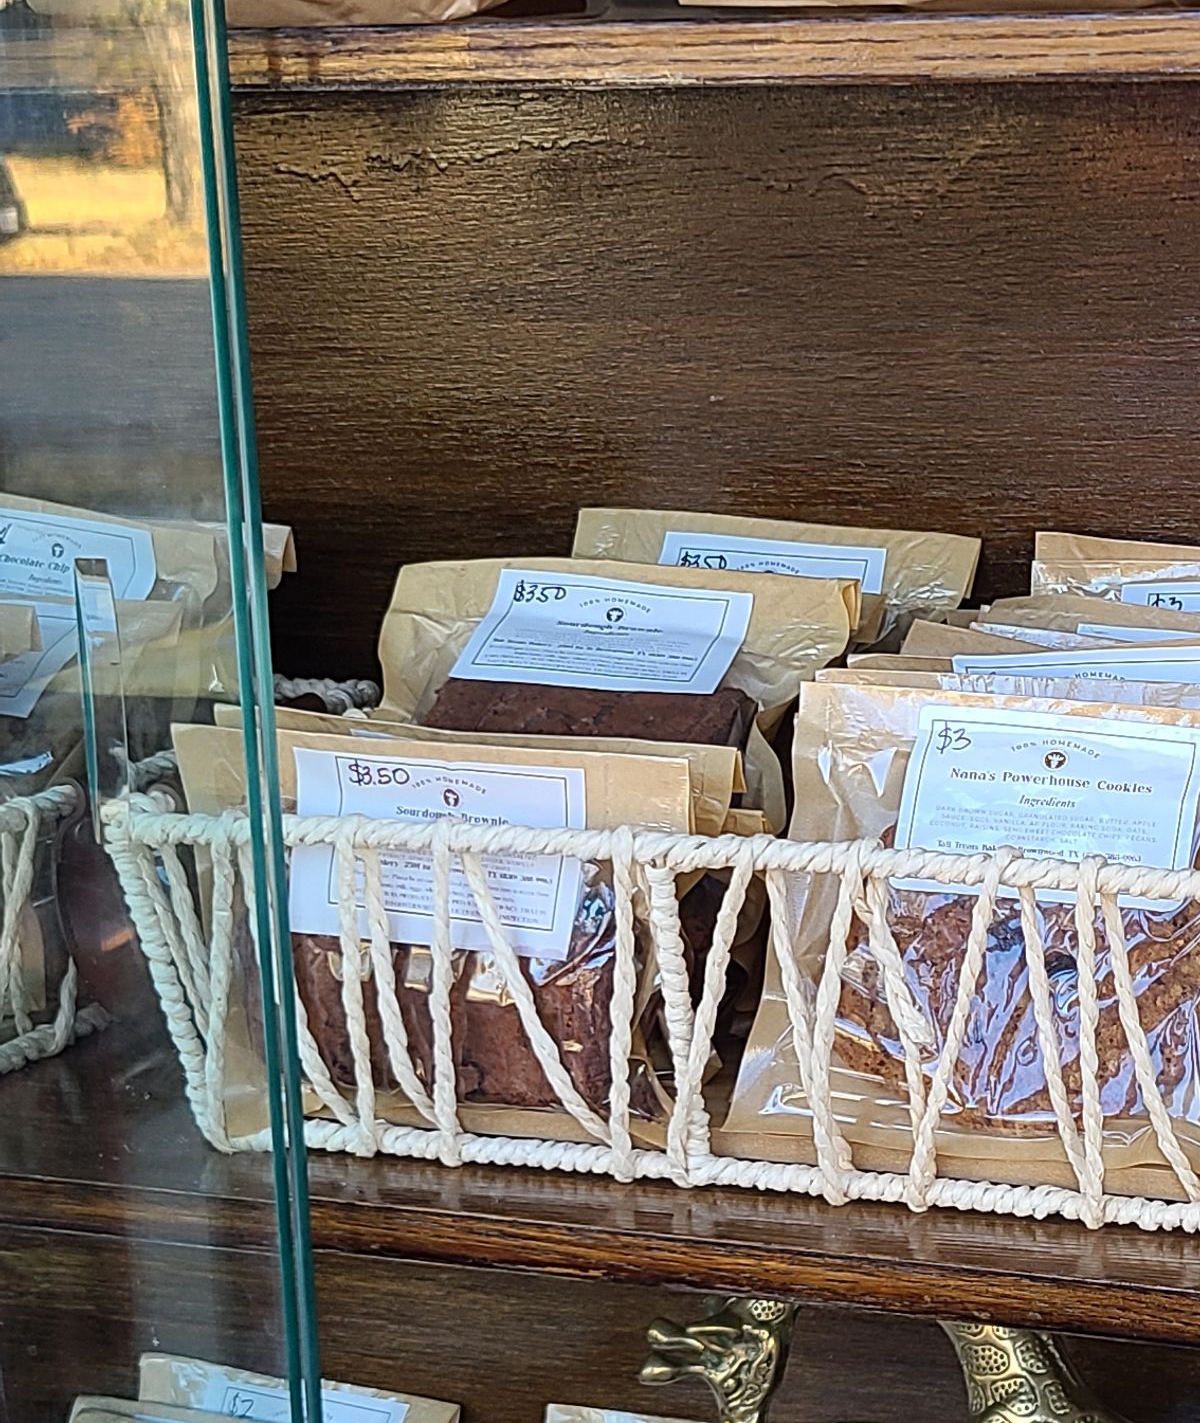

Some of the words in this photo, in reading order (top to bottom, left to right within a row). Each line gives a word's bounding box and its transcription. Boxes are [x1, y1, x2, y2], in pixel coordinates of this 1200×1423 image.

[48, 562, 71, 573] Chip
[604, 597, 652, 613] HOMEMADE
[935, 721, 972, 754] $3
[1011, 741, 1037, 752] 100%
[1042, 739, 1102, 759] HOMEMADE
[349, 760, 410, 786] $3.50
[950, 768, 996, 782] Nana's
[1002, 771, 1091, 789] Powerhouse
[1097, 779, 1153, 794] Cookies
[435, 776, 488, 794] HOMEMADE
[1019, 794, 1076, 809] Ingredients
[227, 1392, 255, 1418] $2
